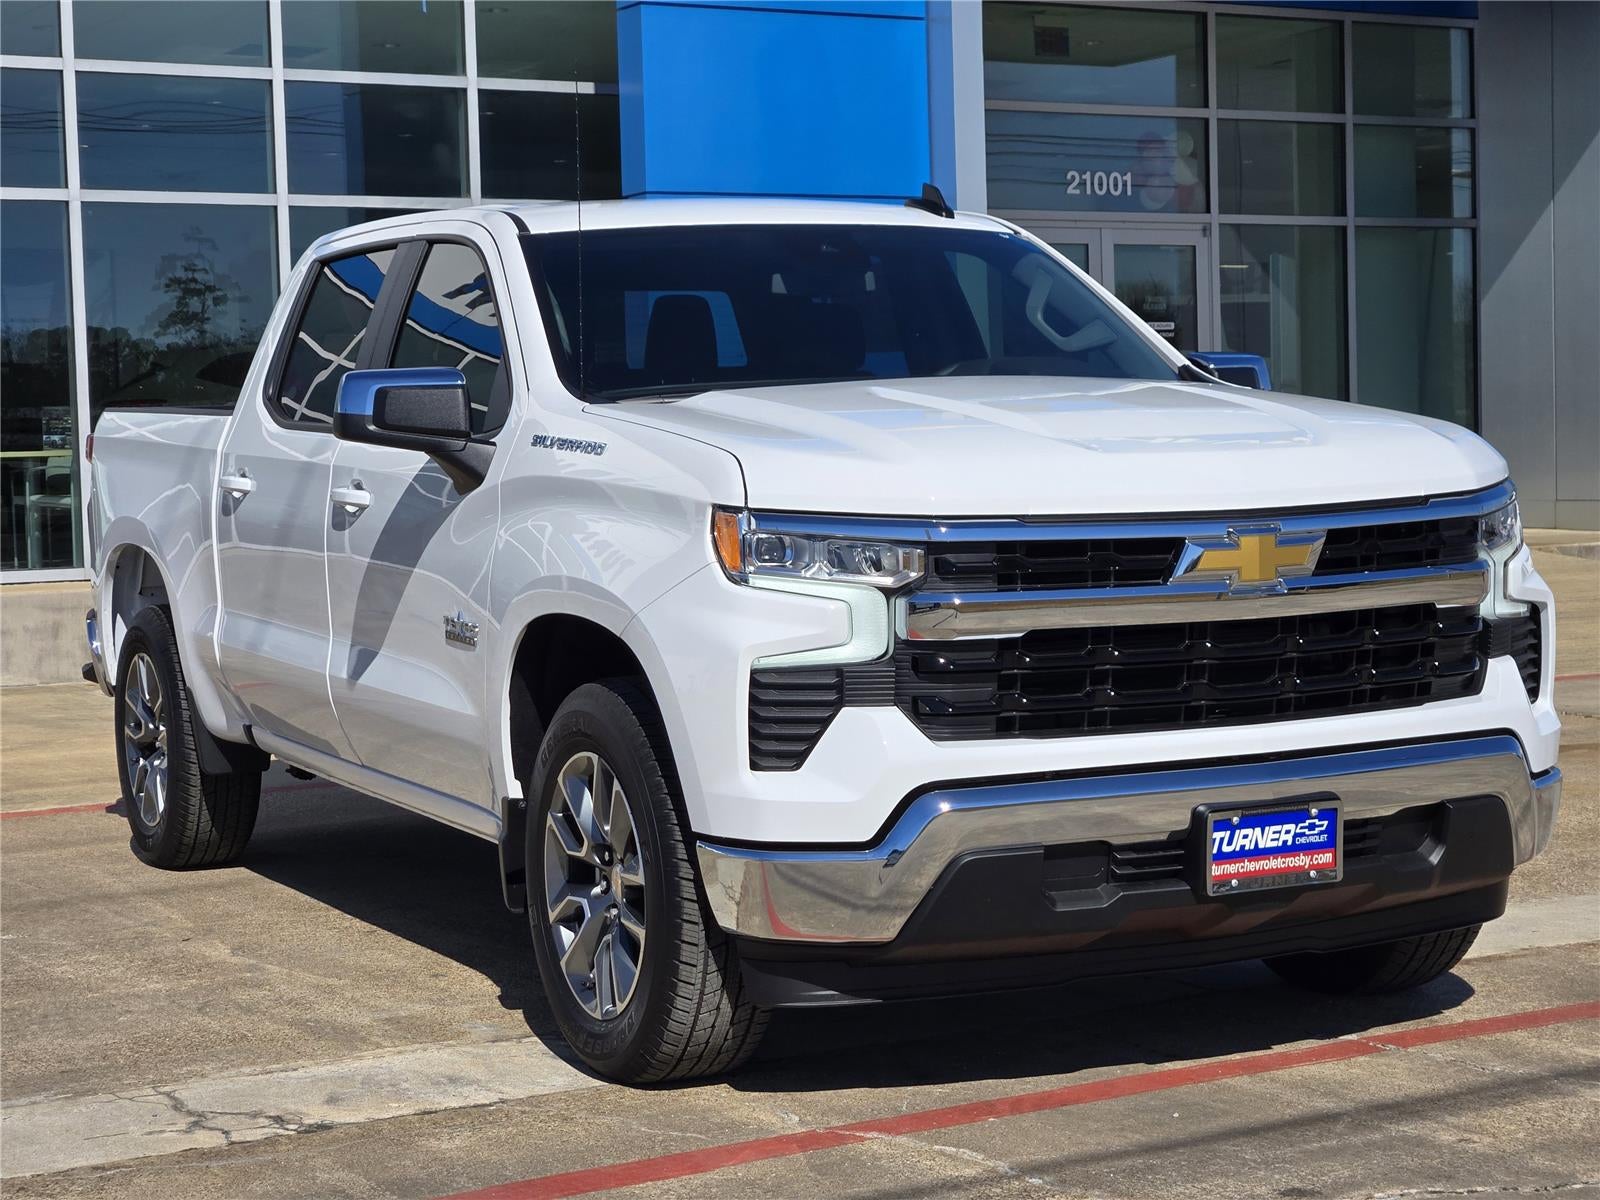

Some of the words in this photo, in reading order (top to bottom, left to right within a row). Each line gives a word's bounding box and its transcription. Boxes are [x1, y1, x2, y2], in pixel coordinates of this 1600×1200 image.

[1066, 170, 1132, 196] 21001
[530, 434, 607, 456] SILVERADO
[1212, 823, 1297, 854] TURNER
[1295, 834, 1328, 845] CHEVROLET
[1211, 852, 1333, 876] turnerchevroletcrosby.com
